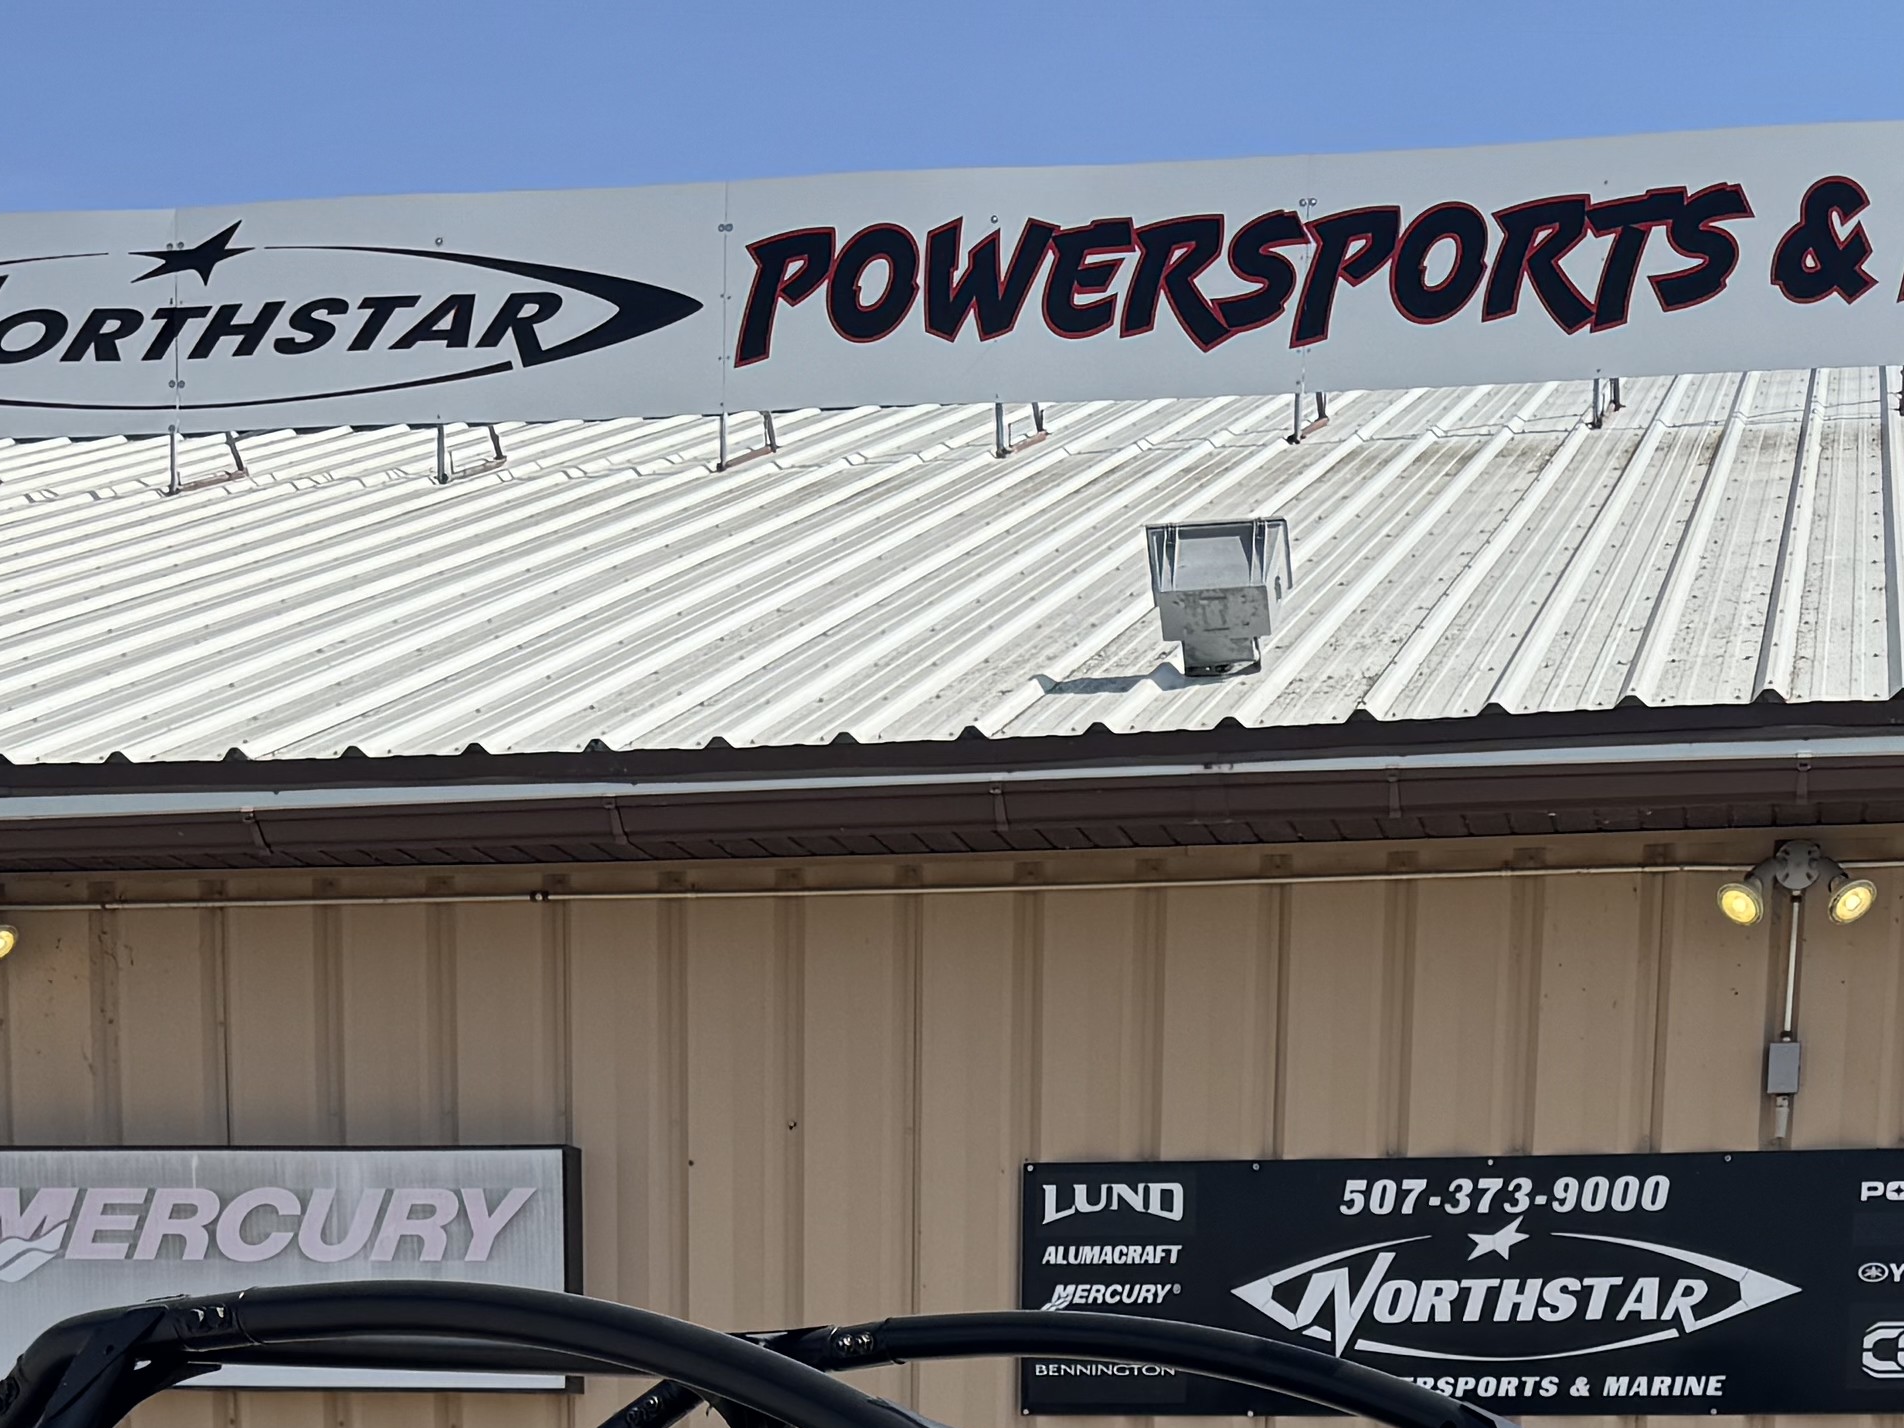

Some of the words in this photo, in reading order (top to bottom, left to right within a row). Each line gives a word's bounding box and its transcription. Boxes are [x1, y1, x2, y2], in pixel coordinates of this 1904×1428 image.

[733, 183, 1755, 367] POWERSPORTS
[1770, 175, 1879, 304] &
[1041, 1182, 1184, 1225] LUND
[1339, 1175, 1671, 1216] 507-373-9000
[1041, 1245, 1183, 1265] ALUMACRAFT
[1295, 1252, 1709, 1358] NORTHSTAR
[1034, 1363, 1176, 1377] BENNINGTON
[1397, 1376, 1560, 1397] RSPORTS
[1569, 1376, 1591, 1397] &
[1602, 1374, 1727, 1397] MARINE
